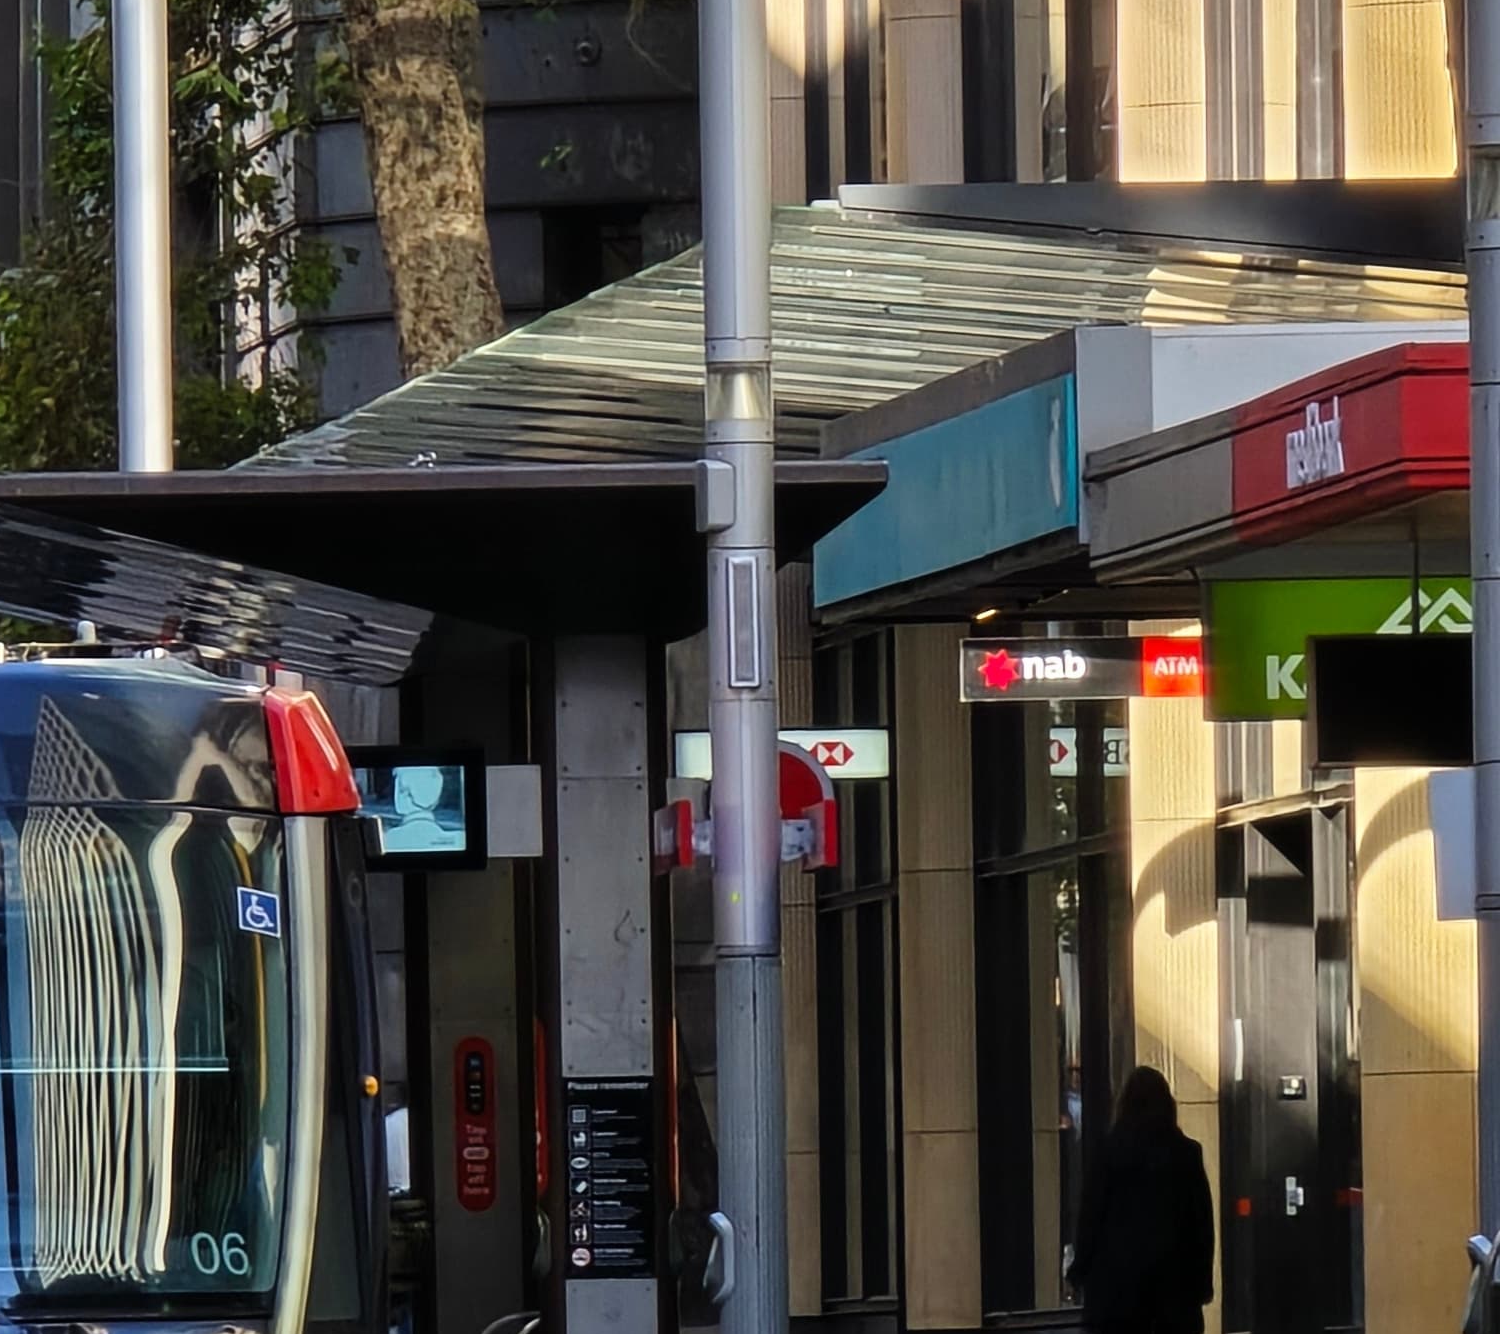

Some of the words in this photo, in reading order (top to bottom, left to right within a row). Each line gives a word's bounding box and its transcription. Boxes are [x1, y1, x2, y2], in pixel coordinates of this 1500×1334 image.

[1022, 649, 1087, 681] nab
[1153, 655, 1199, 677] ATM
[190, 1231, 250, 1276] 06
